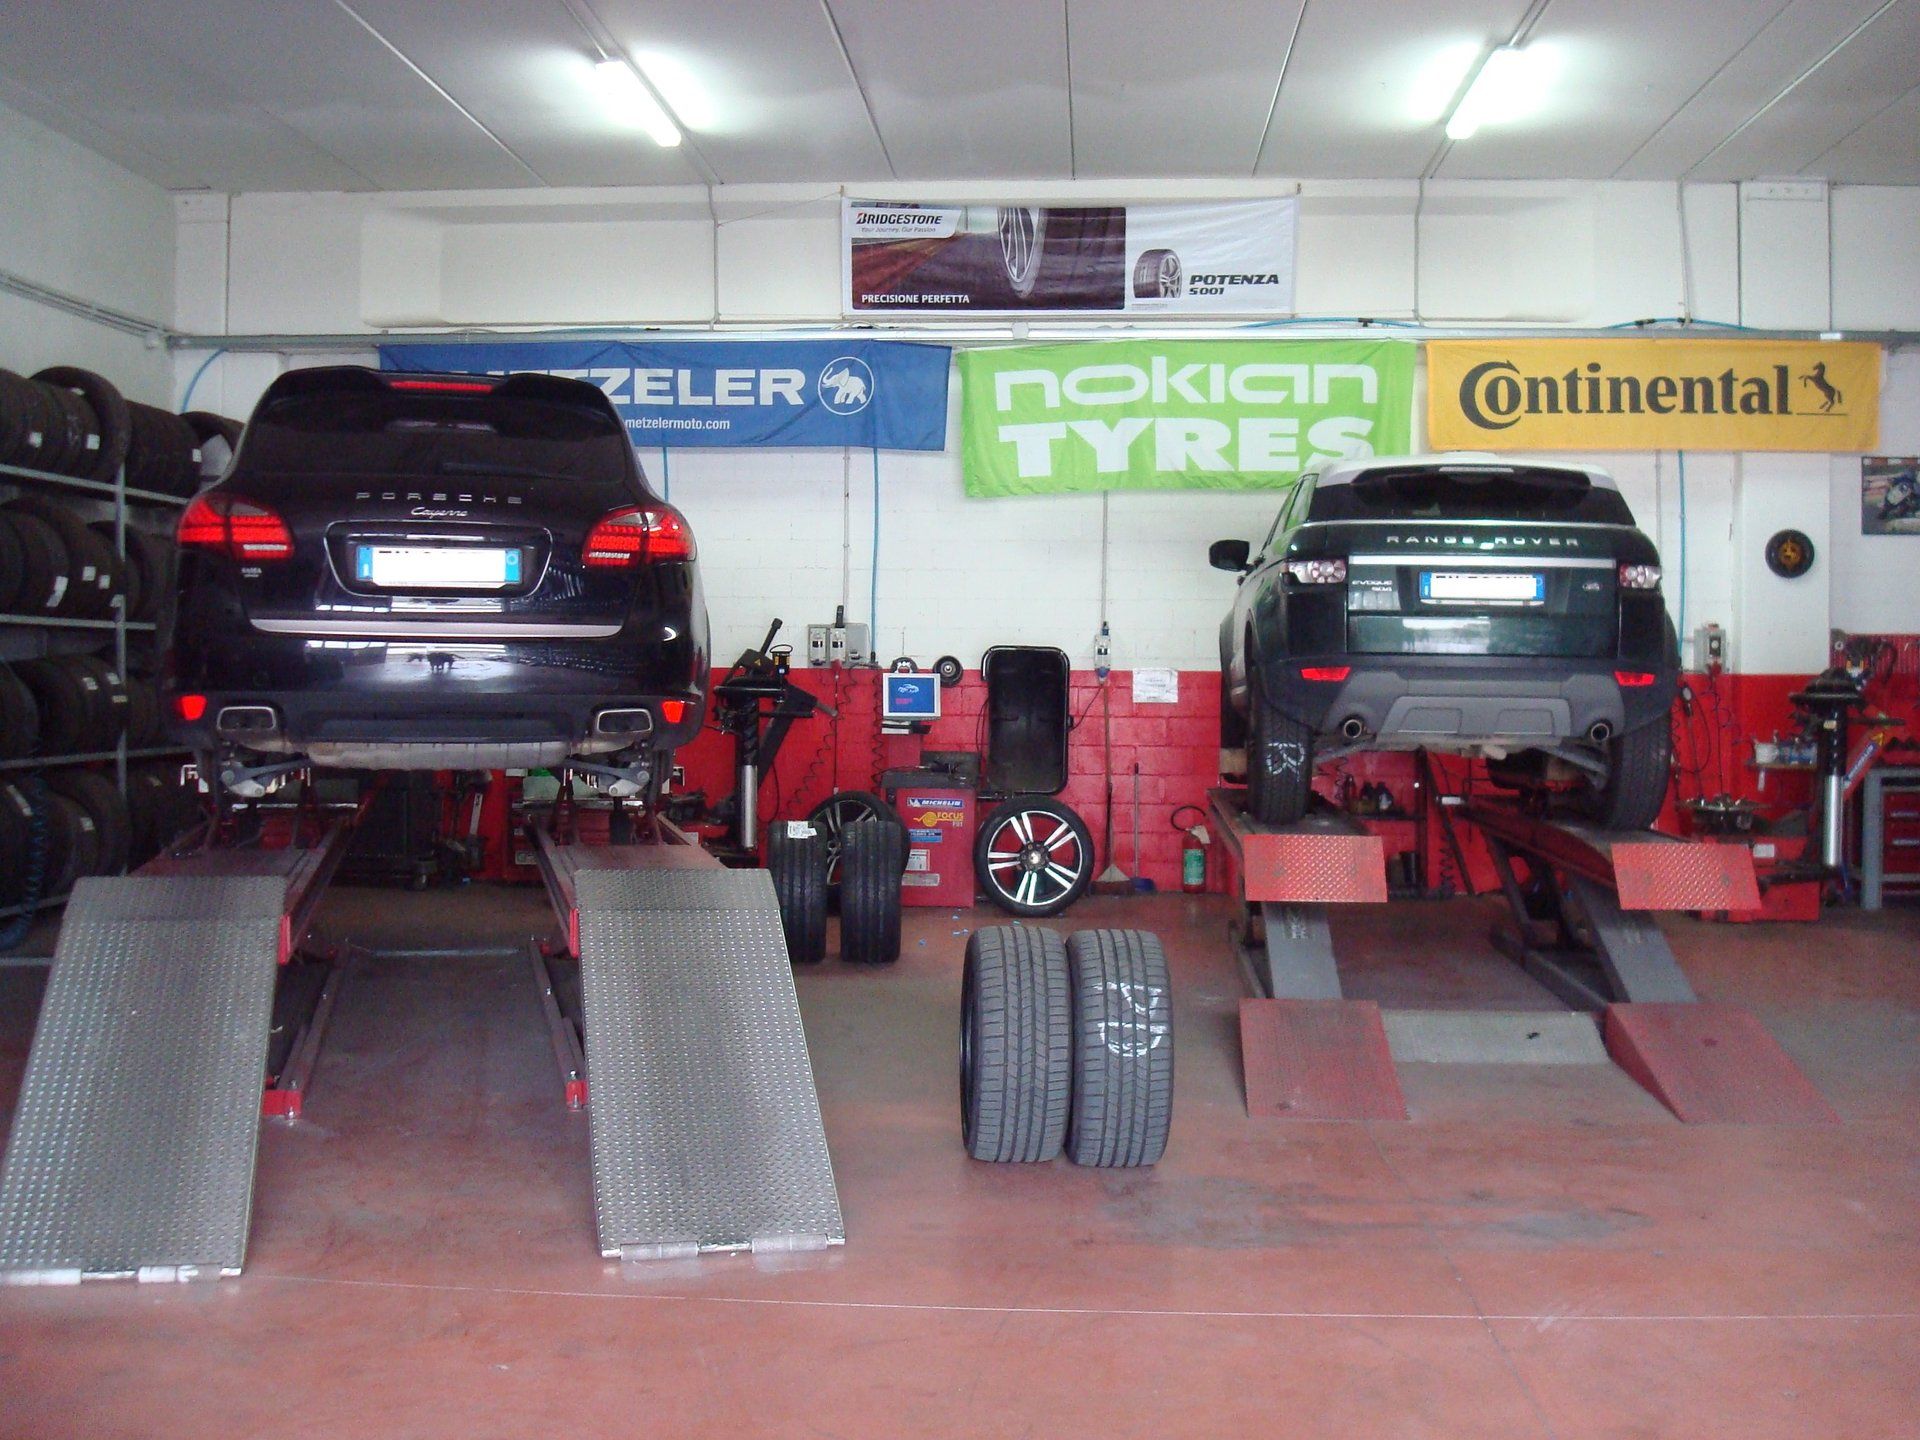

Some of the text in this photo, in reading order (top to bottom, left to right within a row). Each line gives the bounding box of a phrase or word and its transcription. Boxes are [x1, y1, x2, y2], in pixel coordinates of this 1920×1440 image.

[856, 212, 943, 225] BRIDGESTONE
[1189, 274, 1279, 285] POTENZA
[861, 294, 970, 304] PRECISIONE PERFETTA
[451, 366, 804, 406] ZELER
[1459, 359, 1793, 430] Continental
[998, 416, 1375, 478] TYRES
[356, 491, 522, 504] PORSCHE
[410, 506, 469, 519] Cayenne
[1386, 535, 1579, 547] RANGE ROVER
[936, 812, 964, 820] FOCUS
